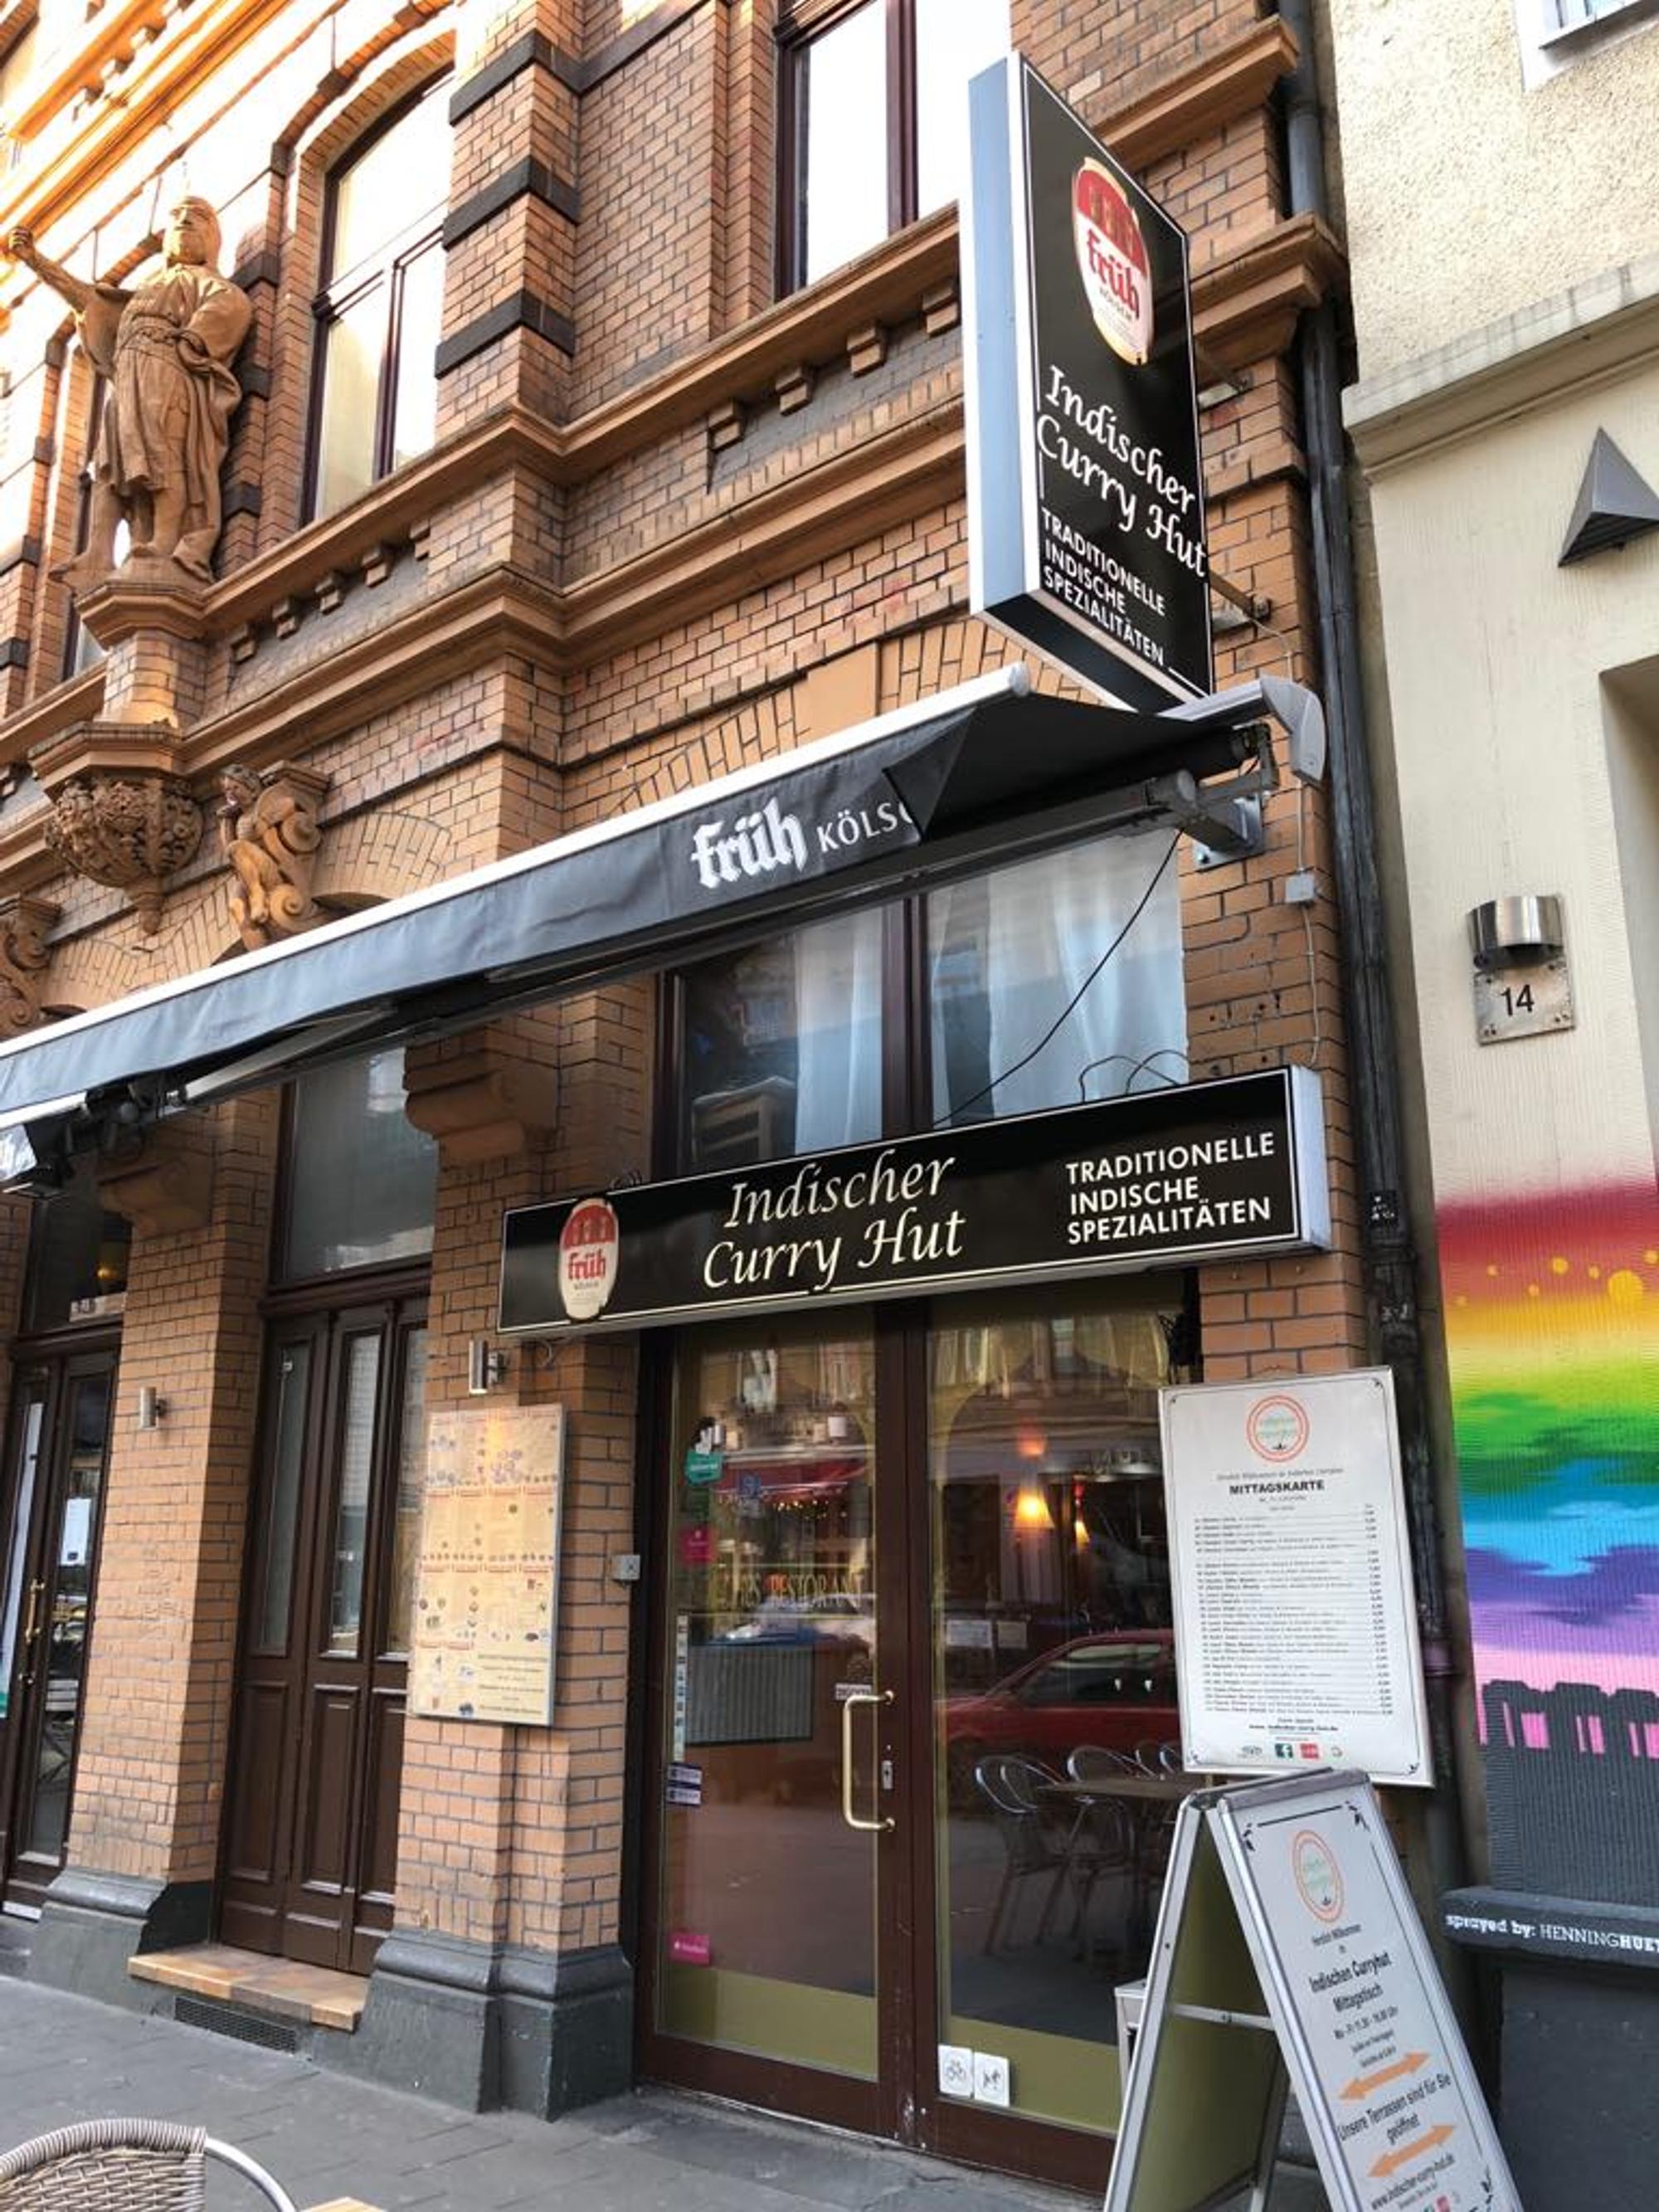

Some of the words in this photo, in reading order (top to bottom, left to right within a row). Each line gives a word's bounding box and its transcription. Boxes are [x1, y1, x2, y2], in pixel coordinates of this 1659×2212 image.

[1087, 228, 1139, 320] früh
[1045, 364, 1195, 515] Indischer
[1037, 414, 1136, 533] Curry
[1145, 502, 1206, 577] Hut
[1042, 507, 1165, 616] TRADITIONELLE
[1044, 539, 1126, 615] INDISCHE
[1043, 568, 1165, 667] SPEZIALITÄTEN
[691, 796, 809, 889] früh
[1500, 984, 1535, 1016] 14
[723, 1148, 956, 1229] Indischer
[1066, 1132, 1275, 1185] TRADITIONELLE
[1070, 1177, 1199, 1215] INDISCHE
[703, 1235, 841, 1292] Curry
[856, 1206, 966, 1269] Hut
[1068, 1196, 1271, 1244] SPEZIALITÄTEN
[568, 1248, 606, 1279] früh
[1229, 1480, 1326, 1494] MITTAGSKARTE
[1445, 1914, 1507, 1934] sprayed
[1510, 1919, 1536, 1938] by:
[1337, 2117, 1369, 2141] Unsere
[1366, 2096, 1408, 2124] Terrassen
[1406, 2083, 1425, 2105] sind
